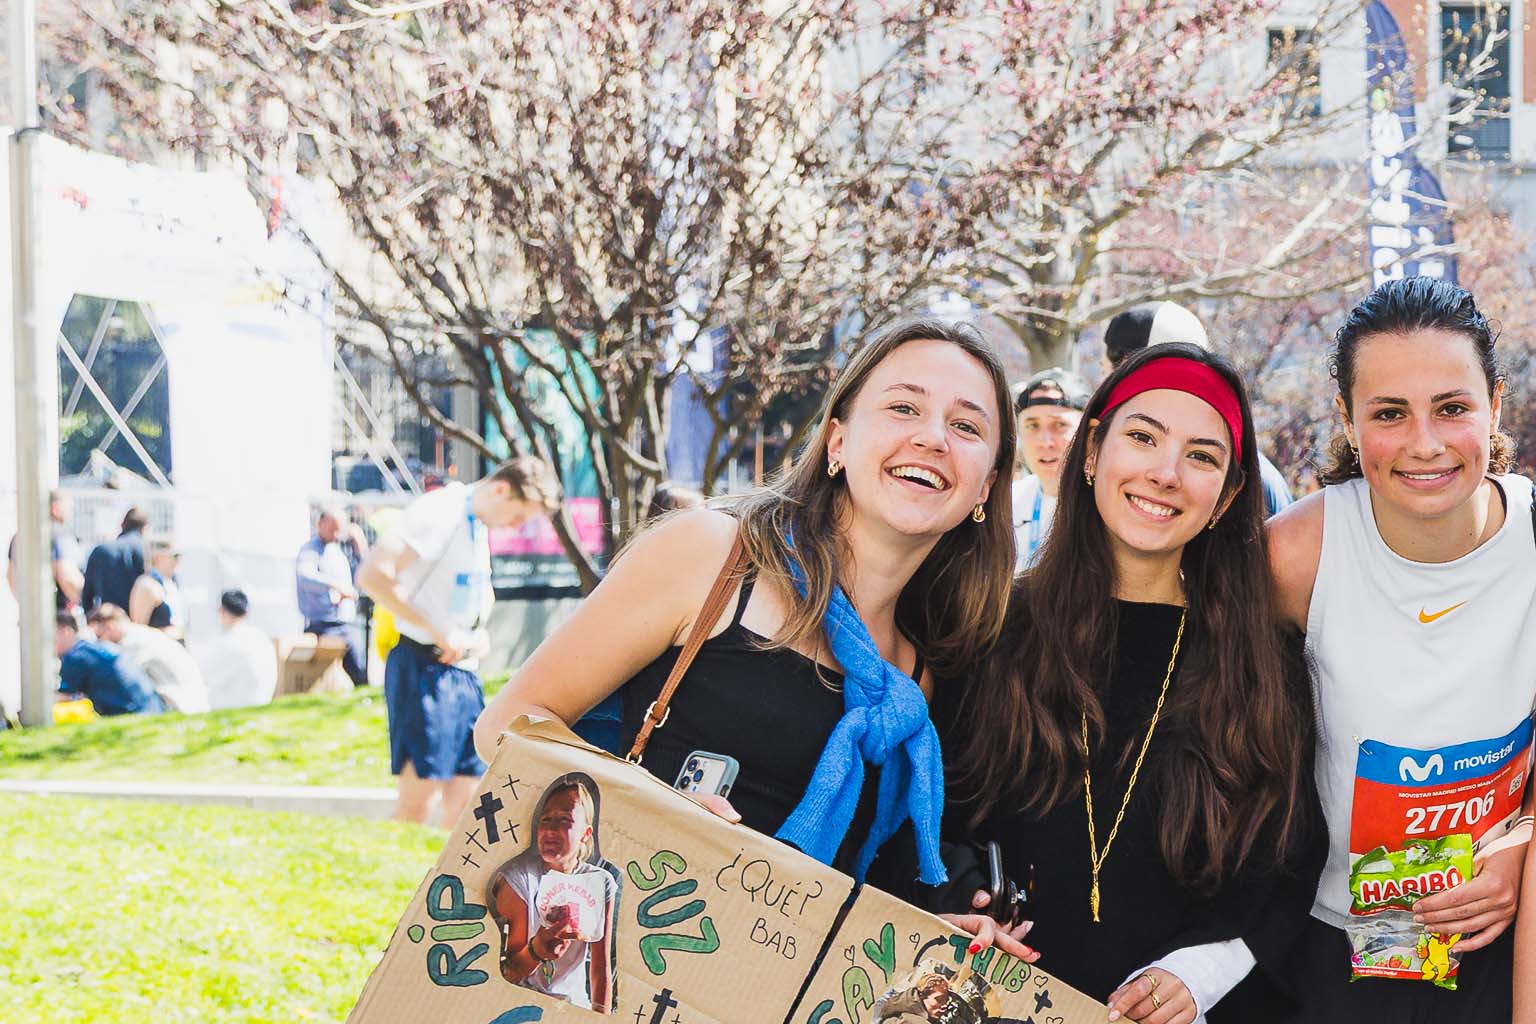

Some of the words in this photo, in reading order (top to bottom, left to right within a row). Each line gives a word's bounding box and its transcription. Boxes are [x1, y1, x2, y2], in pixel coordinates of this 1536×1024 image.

[1453, 740, 1516, 771] movistar
[1404, 789, 1495, 835] 27706
[715, 848, 824, 920] ¿QUÉ?
[626, 849, 721, 976] SUZ
[749, 917, 798, 960] BAB
[949, 934, 1032, 994] THIB
